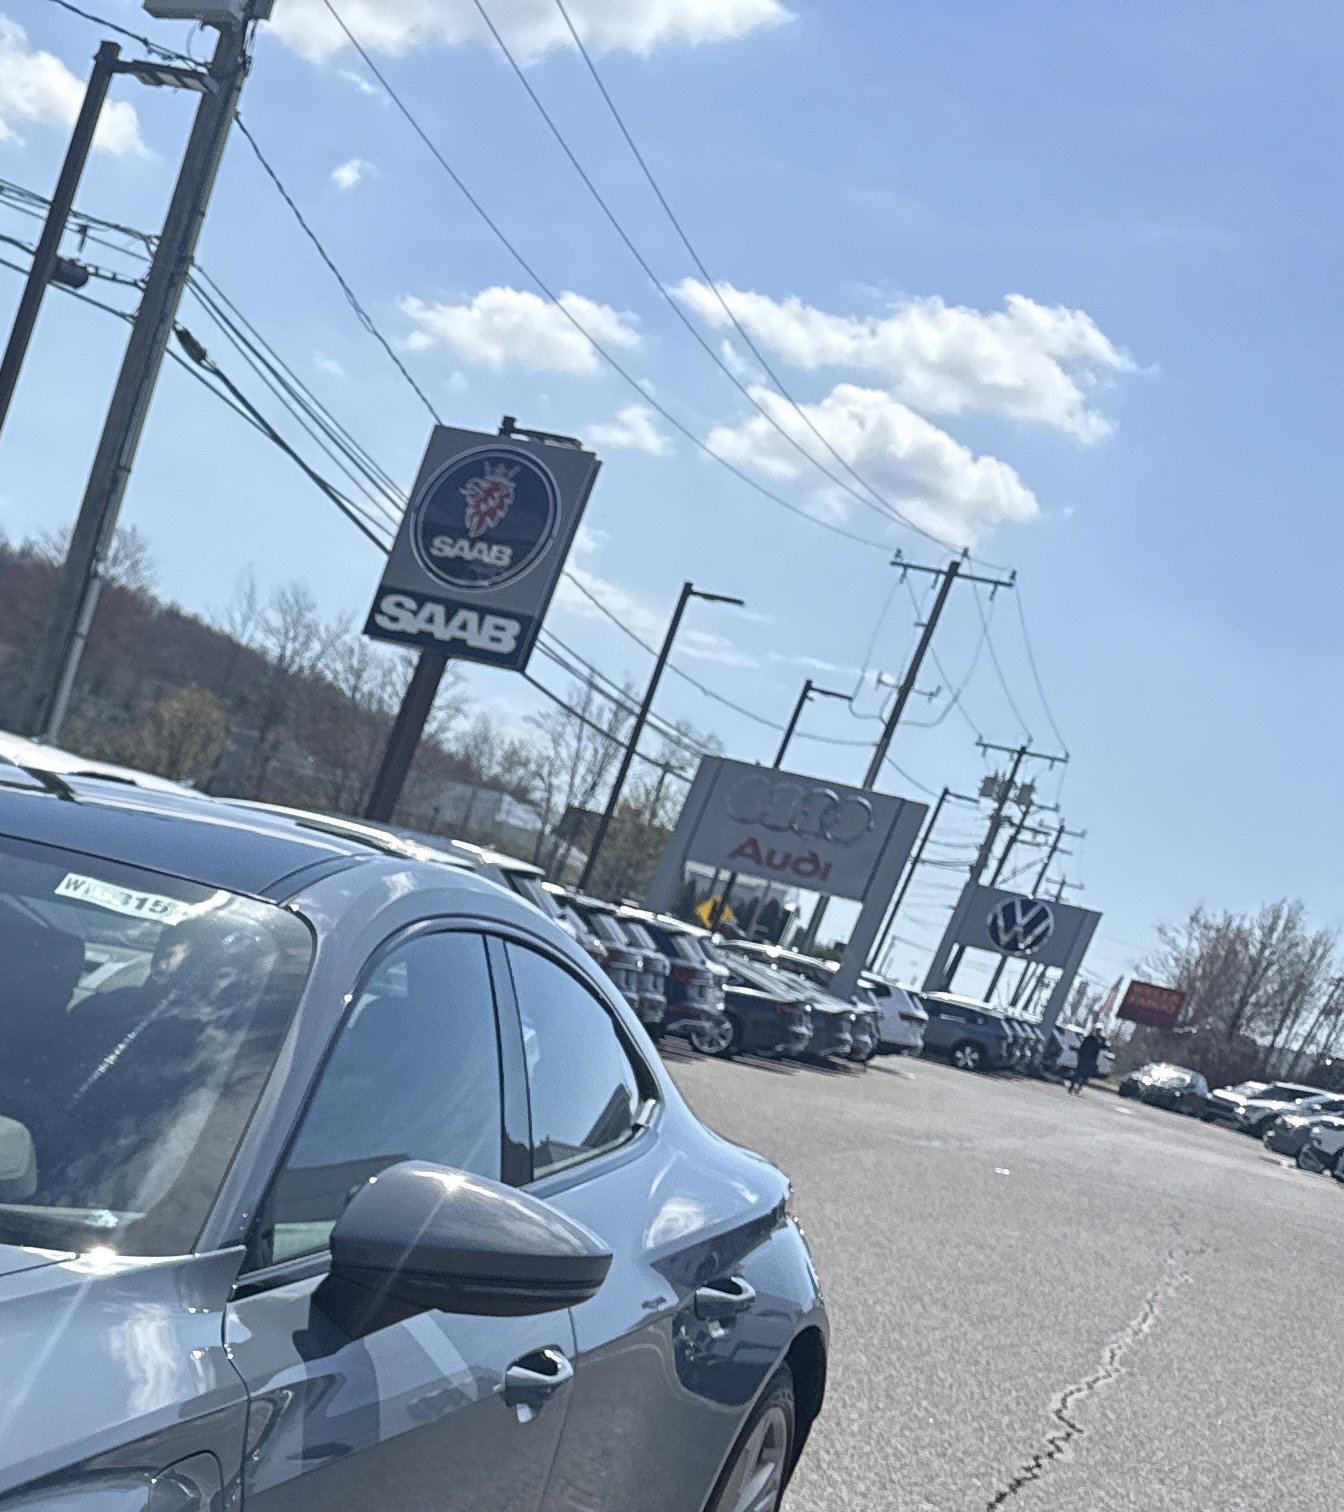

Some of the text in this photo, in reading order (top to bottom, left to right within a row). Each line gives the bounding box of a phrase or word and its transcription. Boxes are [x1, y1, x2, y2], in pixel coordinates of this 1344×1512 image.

[430, 535, 514, 567] SAAB
[373, 593, 522, 655] SAAB
[727, 836, 833, 882] Audi
